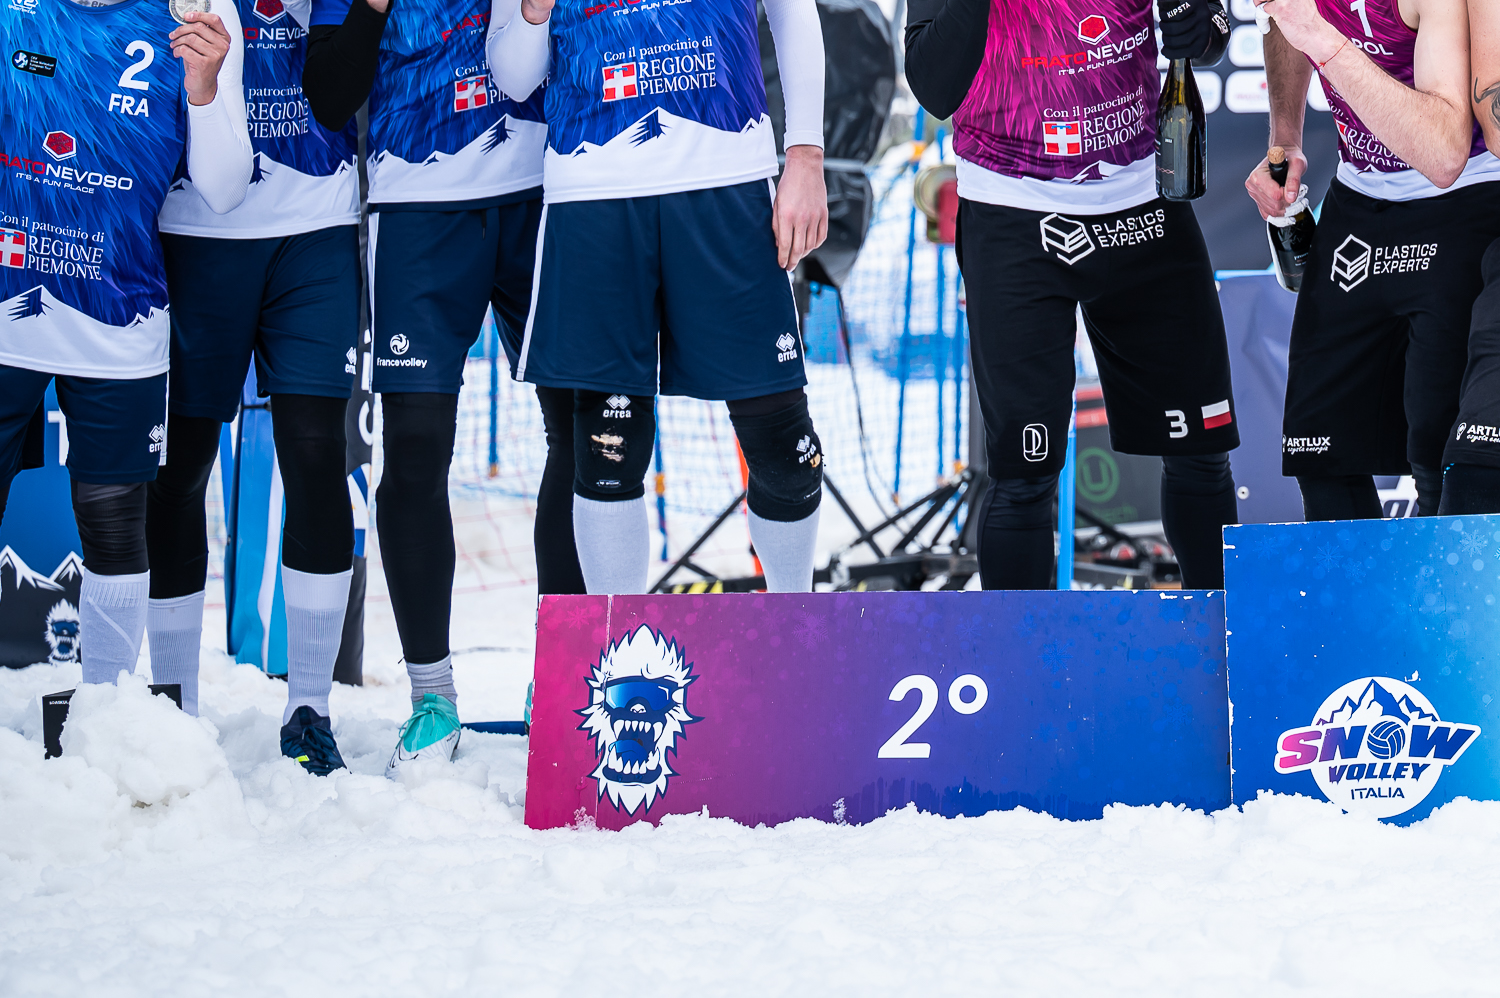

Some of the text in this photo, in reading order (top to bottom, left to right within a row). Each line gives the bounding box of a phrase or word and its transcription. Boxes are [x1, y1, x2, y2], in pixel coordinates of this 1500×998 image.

[641, 2, 660, 11] FUN
[1167, 2, 1190, 19] KIPSTA
[603, 36, 713, 62] Con il patrocinio di
[1021, 27, 1149, 69] PRATONEVOSO
[1351, 38, 1394, 55] POL
[118, 40, 155, 90] 2
[455, 65, 478, 77] Con
[639, 52, 716, 79] REGIONE
[1077, 66, 1085, 74] A
[1086, 61, 1105, 71] FUN
[1106, 52, 1133, 66] PLACE
[639, 72, 717, 96] PIEMONTE
[108, 93, 149, 117] FRA
[1043, 84, 1143, 119] Con il patrocinio di
[1082, 98, 1145, 138] REGIONE
[1083, 117, 1145, 153] PIEMONTE
[0, 154, 133, 190] RATONEVOSO
[43, 179, 61, 188] FUN
[64, 183, 95, 194] PLACE
[22, 216, 29, 228] il
[32, 221, 88, 240] patrocinio
[92, 232, 105, 243] di
[1092, 208, 1165, 236] PLASTICS
[1097, 224, 1165, 248] EXPERTS
[28, 234, 104, 264] REGIONE
[1375, 243, 1438, 261] PLASTICS
[27, 254, 102, 280] PIEMONTE
[1373, 258, 1430, 275] EXPERTS
[377, 357, 427, 368] francevolley
[602, 409, 632, 419] errea
[1165, 409, 1189, 438] 3
[1287, 436, 1331, 447] ARTLUX
[1328, 761, 1431, 784] VOLLEY
[1350, 785, 1405, 800] ITALIA
